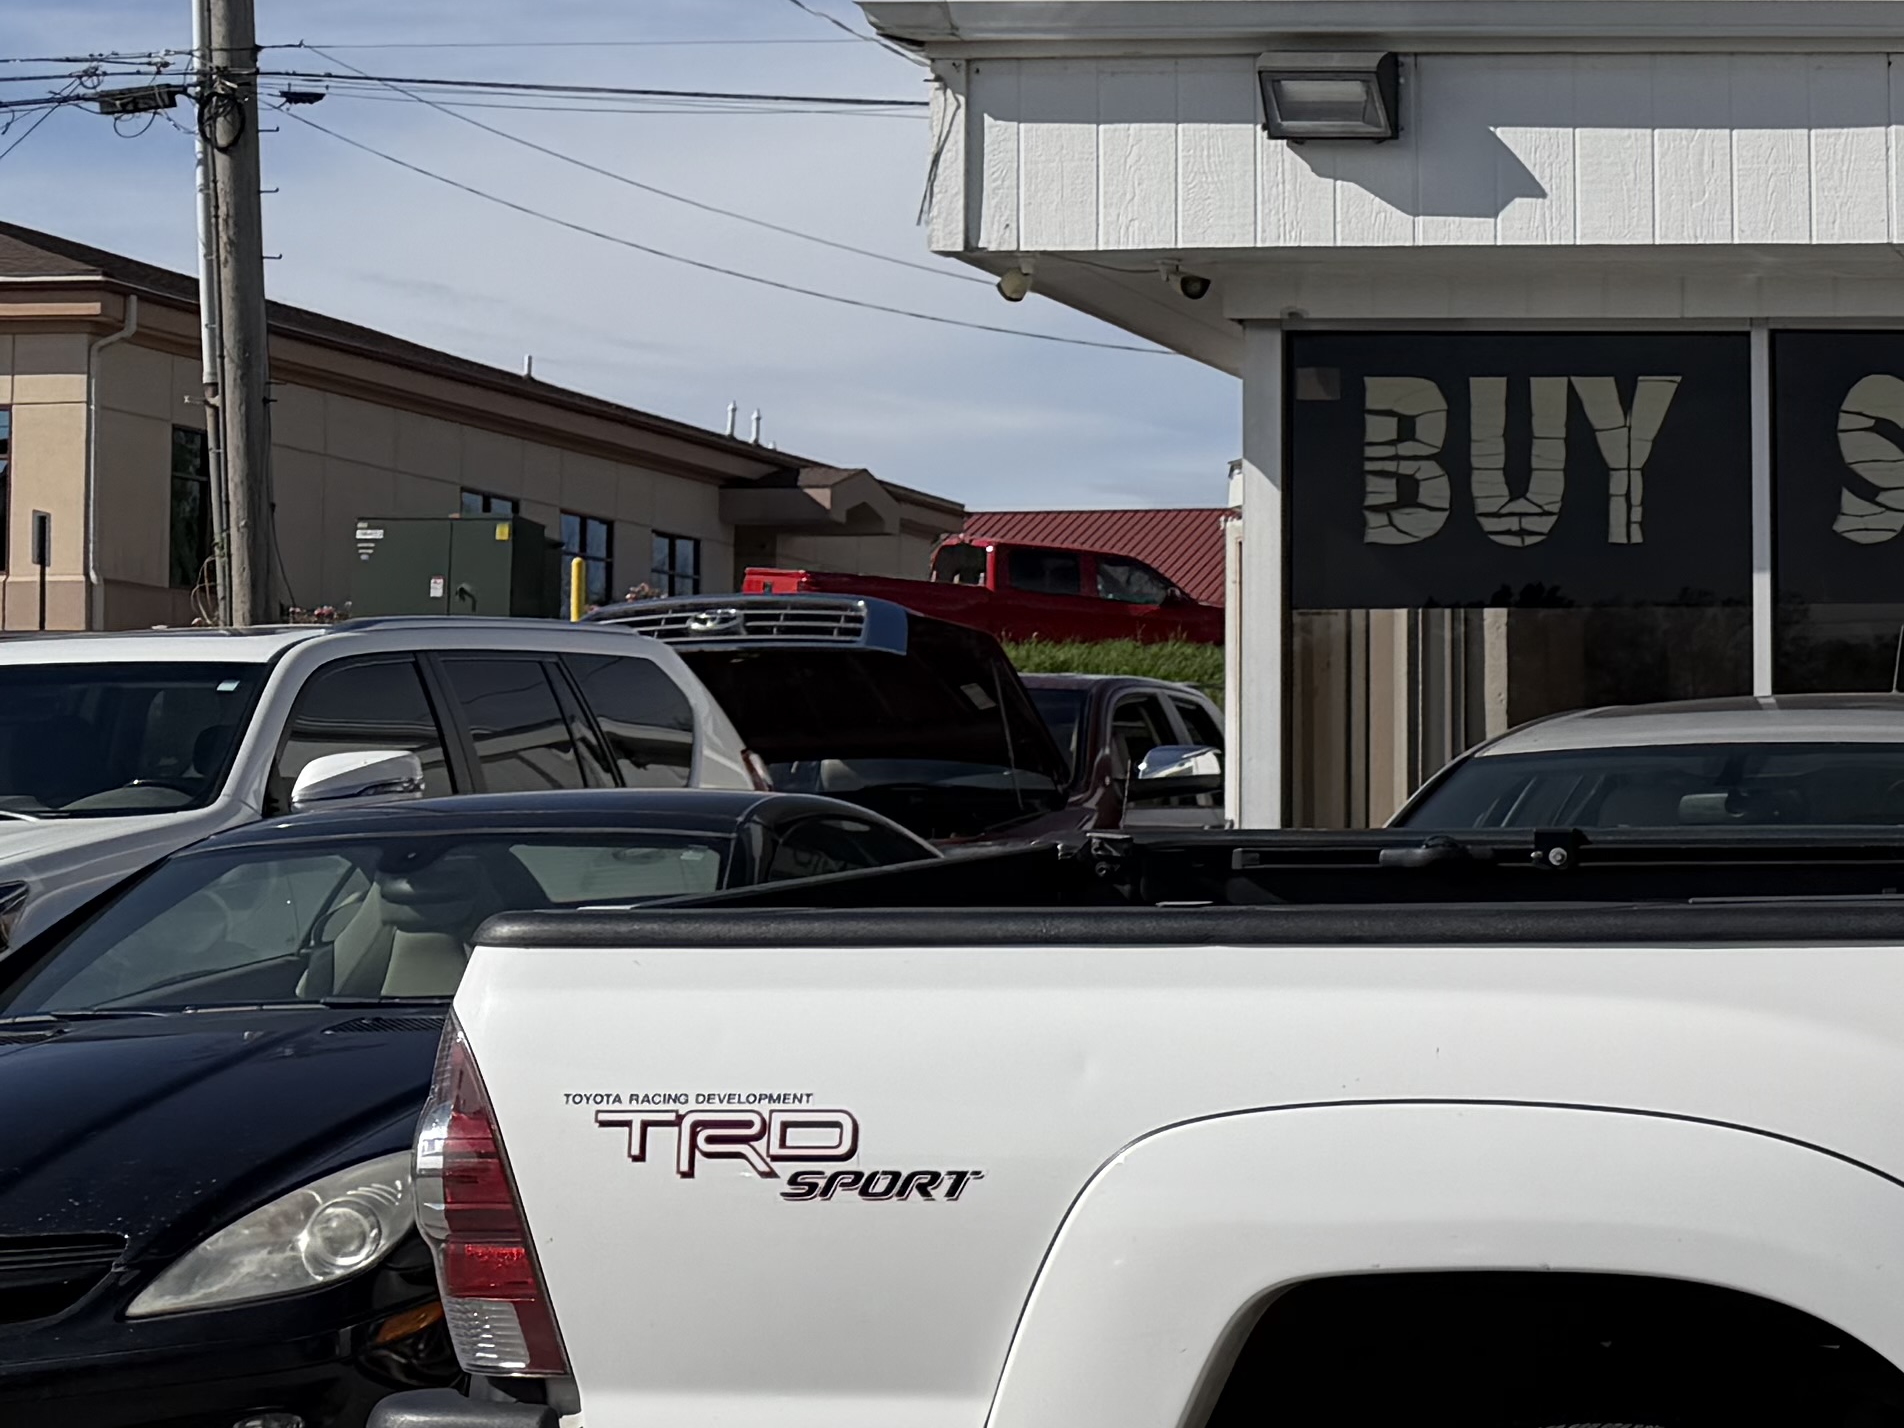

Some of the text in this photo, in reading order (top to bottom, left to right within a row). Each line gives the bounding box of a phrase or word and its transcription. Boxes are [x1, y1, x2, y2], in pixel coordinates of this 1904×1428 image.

[1362, 374, 1682, 546] BUY
[563, 1092, 814, 1105] TOYOTA RACING DEVELOPMENT
[594, 1108, 860, 1179] TRD
[779, 1169, 987, 1202] SPORT
